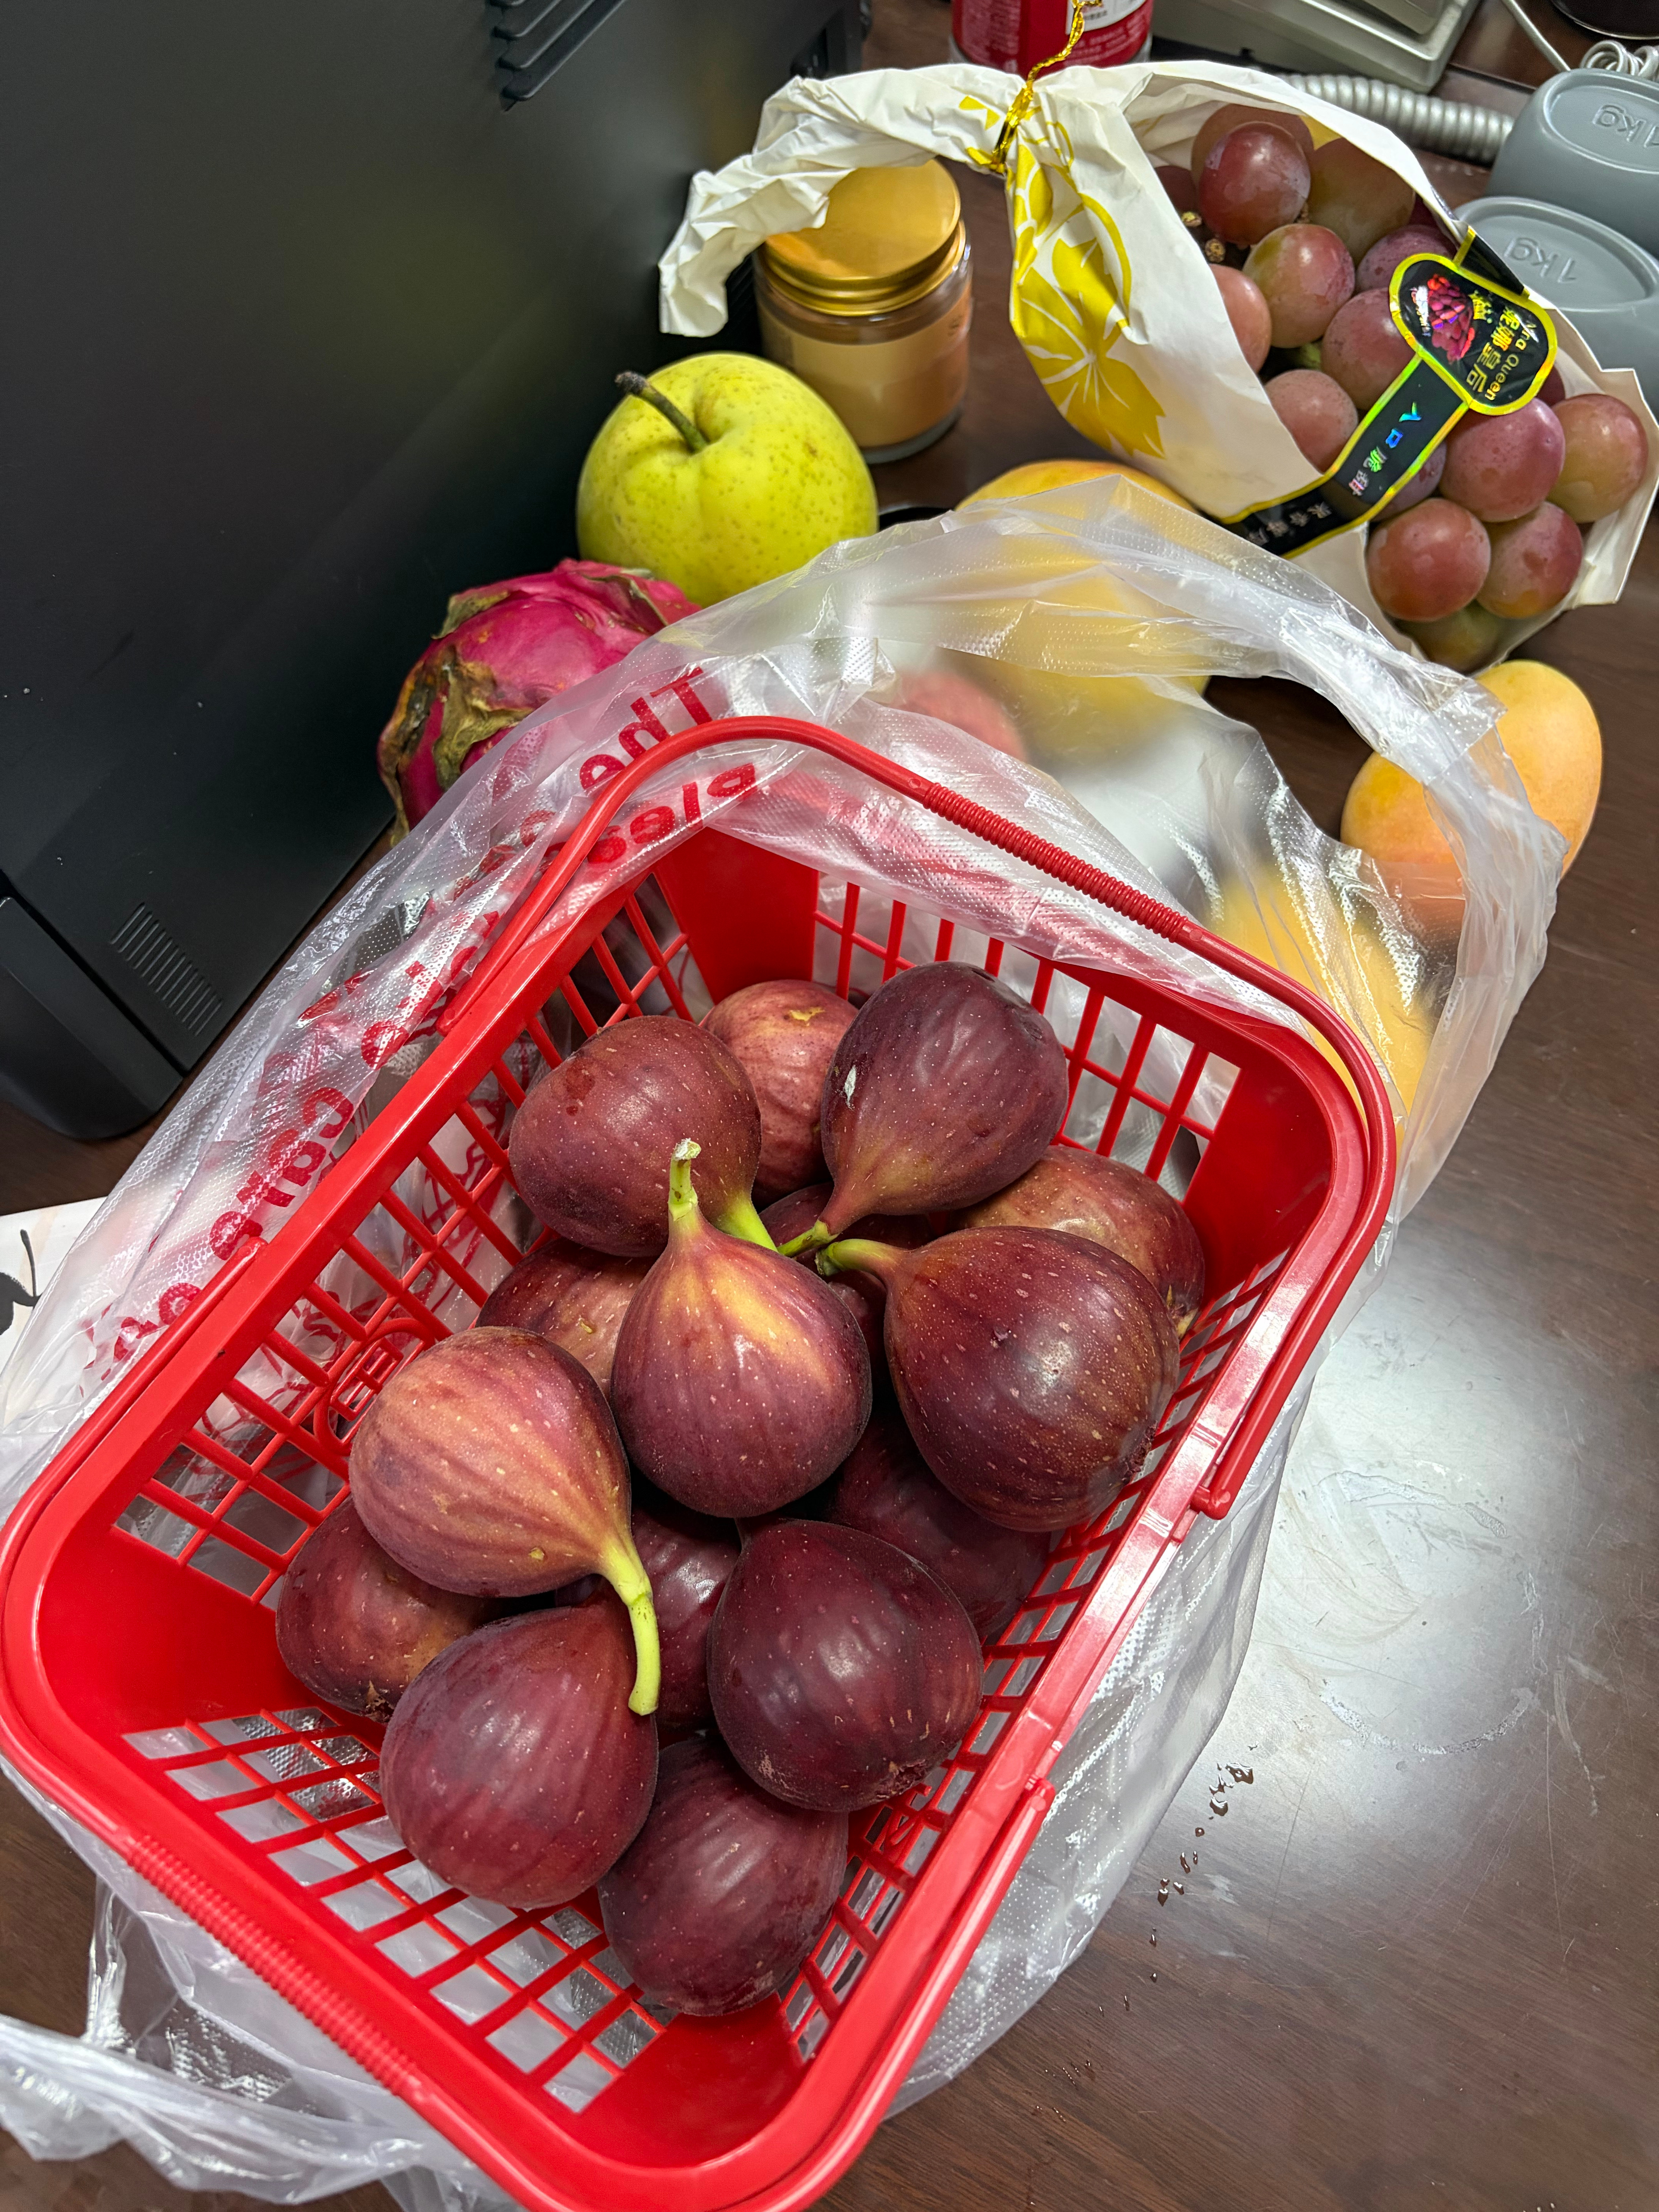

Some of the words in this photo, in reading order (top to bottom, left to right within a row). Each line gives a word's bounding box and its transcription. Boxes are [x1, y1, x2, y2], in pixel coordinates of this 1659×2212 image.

[1504, 237, 1577, 283] 1kg
[1466, 306, 1520, 393] 妮娜皇后
[1485, 354, 1520, 400] Queen
[1348, 402, 1422, 496] 入口脆甜
